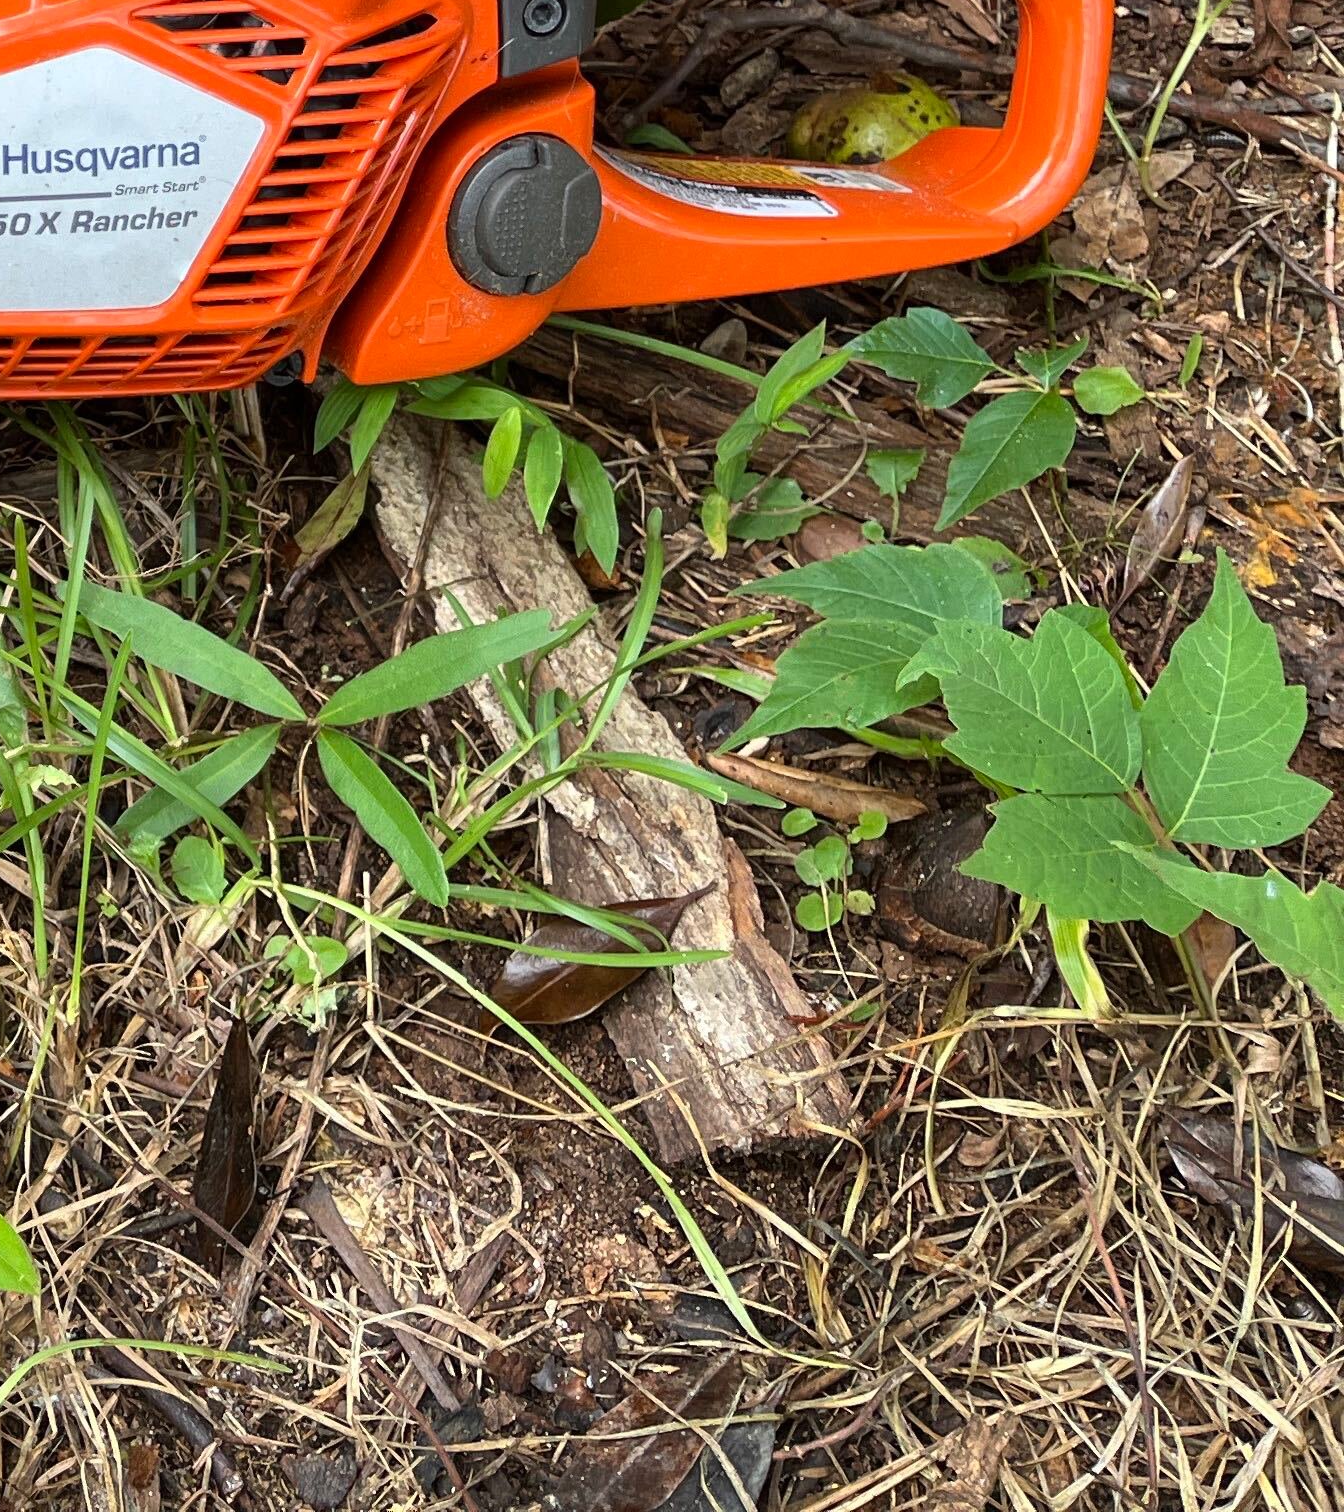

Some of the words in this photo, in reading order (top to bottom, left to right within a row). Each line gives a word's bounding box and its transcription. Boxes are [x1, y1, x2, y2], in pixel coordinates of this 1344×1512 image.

[2, 141, 200, 177] Husqvarna
[115, 184, 159, 196] Smart
[162, 180, 200, 193] Start
[34, 211, 62, 235] X
[70, 206, 198, 234] Rancher
